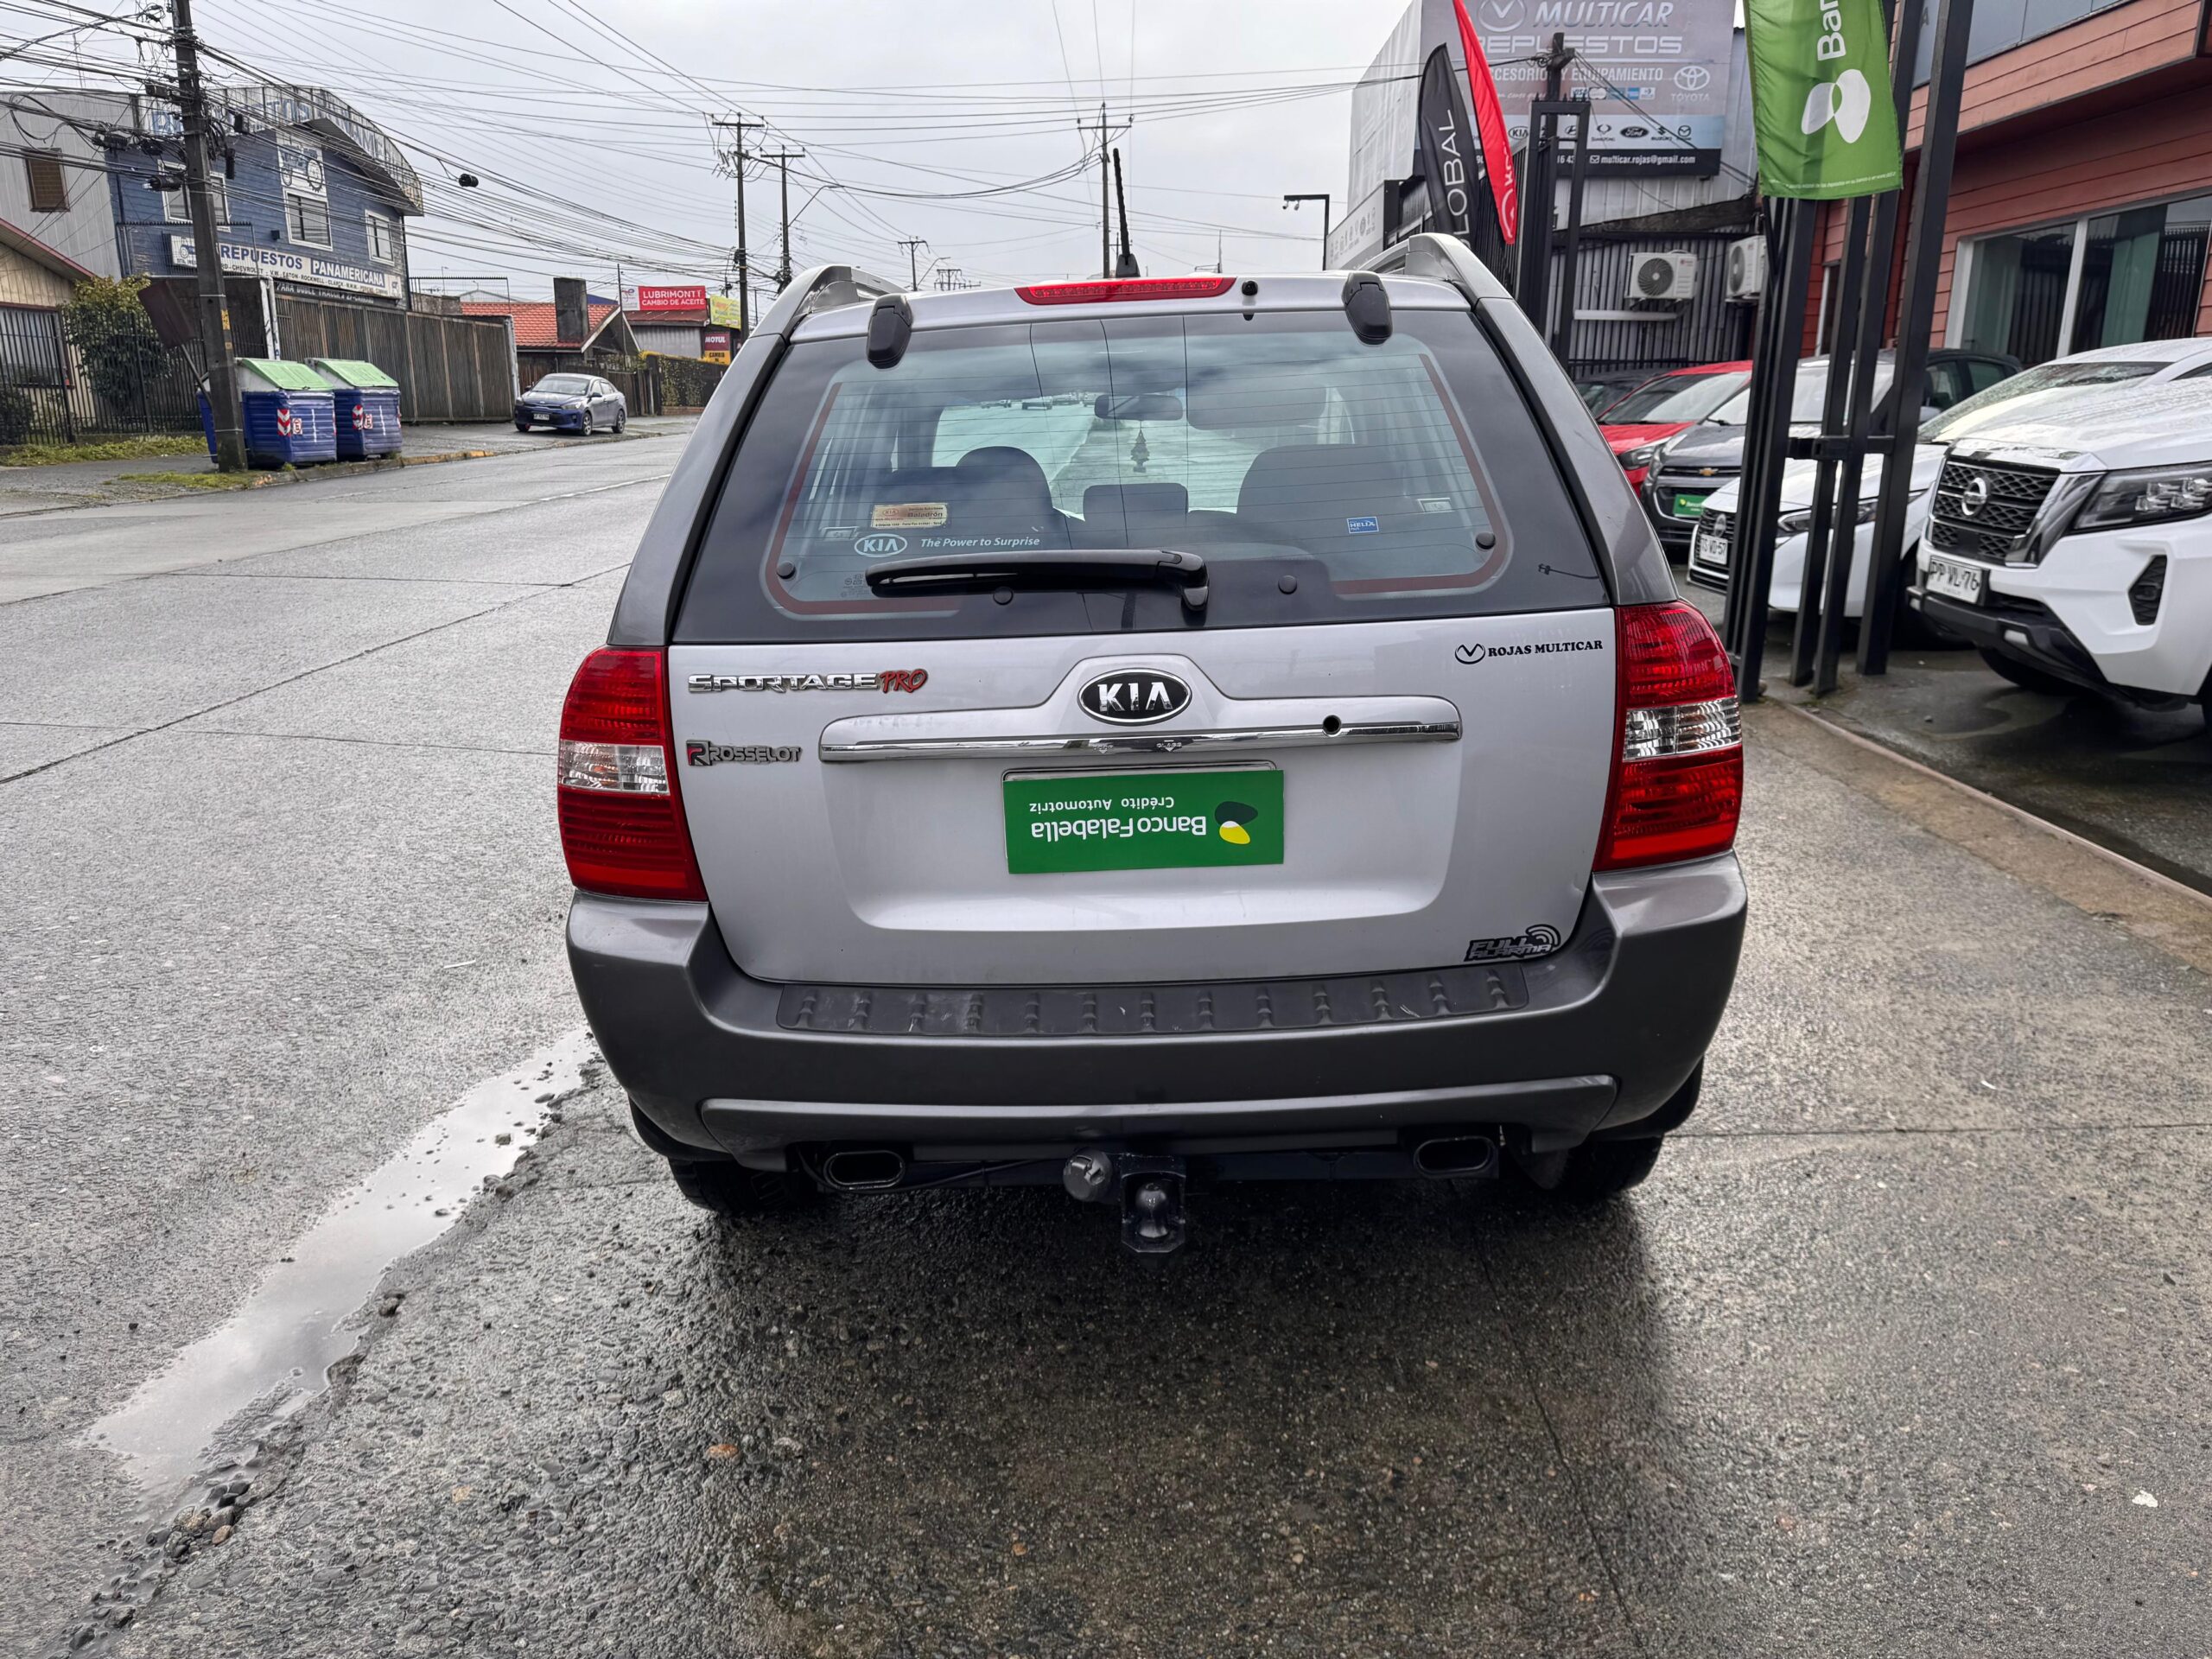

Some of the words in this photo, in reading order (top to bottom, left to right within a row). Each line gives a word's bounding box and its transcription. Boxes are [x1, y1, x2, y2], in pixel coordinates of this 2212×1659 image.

[1534, 2, 1674, 27] MULTICAR
[1572, 67, 1663, 81] EQUIPAMIENTO
[1671, 92, 1710, 102] TOYOTA
[1600, 154, 1696, 165] multicar.rojas@gmail.com
[1439, 110, 1471, 242] LOBAL
[220, 245, 302, 270] REPUESTOS
[313, 260, 384, 287] PANAMERICANA
[863, 538, 899, 552] KIA
[921, 538, 942, 547] The
[943, 538, 976, 548] Power
[980, 537, 991, 547] to
[993, 536, 1040, 549] Surprise
[1488, 645, 1532, 658] ROJAS
[1535, 640, 1604, 654] MULTICAR
[689, 673, 879, 693] SPORTAGE
[879, 669, 929, 694] PRO
[1097, 681, 1174, 712] KIA
[709, 747, 802, 764] ROSSELOT
[1029, 798, 1113, 814] Automotriz
[1121, 797, 1175, 810] Crédito
[1470, 938, 1535, 951] FULL
